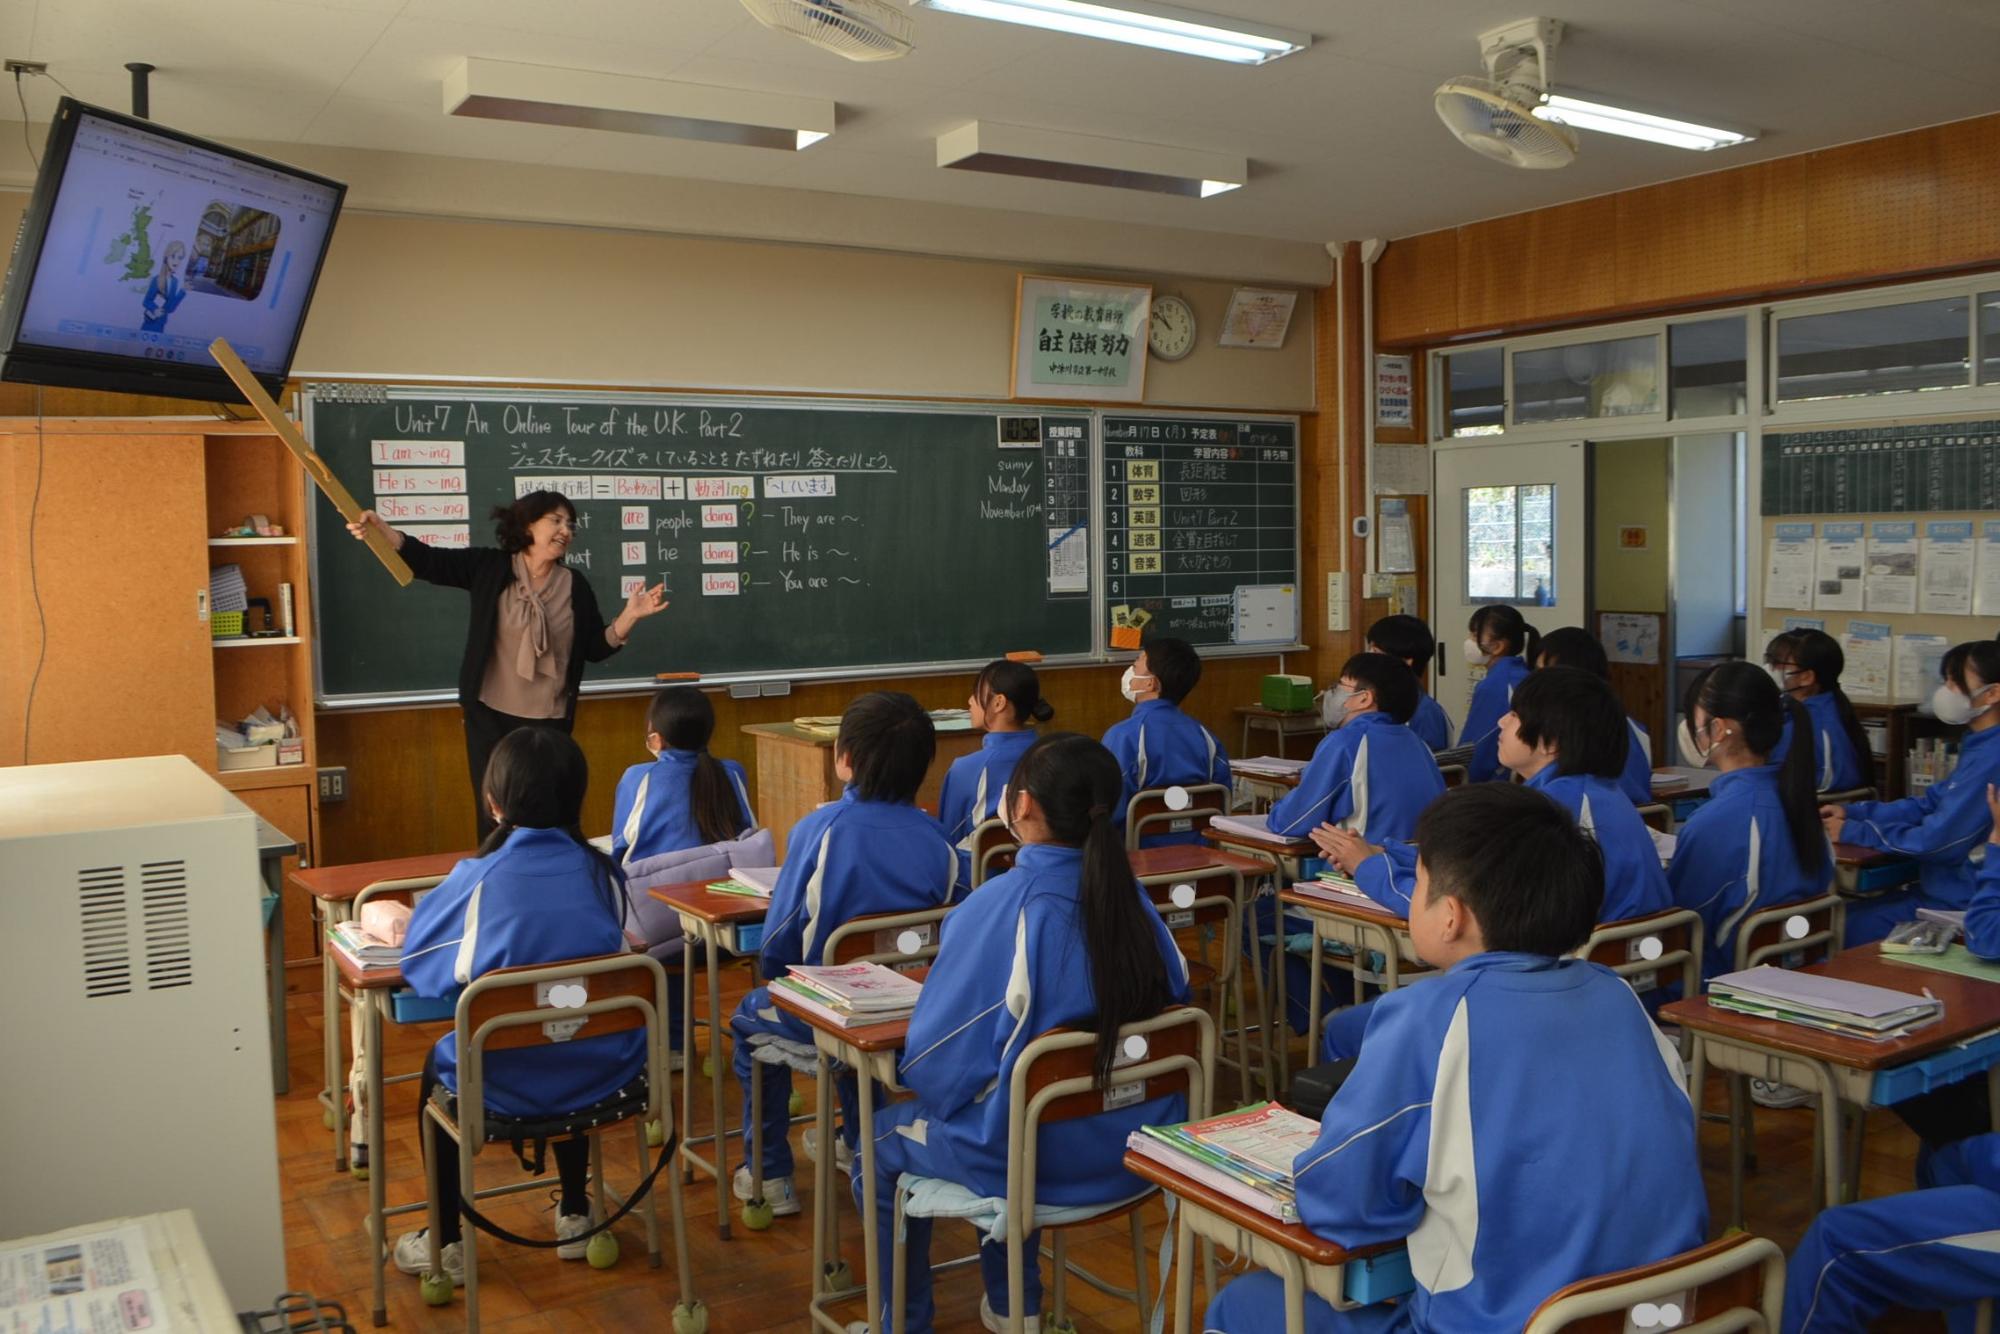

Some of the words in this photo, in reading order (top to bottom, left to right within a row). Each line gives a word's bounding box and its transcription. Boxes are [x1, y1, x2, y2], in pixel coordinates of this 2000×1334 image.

[1039, 328, 1064, 352] 自主
[1069, 332, 1097, 355] 信頼
[1101, 334, 1129, 357] 努力
[465, 403, 489, 436] An
[503, 404, 552, 434] Online
[562, 407, 595, 435] Tour
[600, 407, 619, 436] of
[625, 412, 648, 436] the
[655, 410, 688, 436] U.K.
[1128, 425, 1137, 438] 月
[1151, 426, 1160, 438] 日
[1191, 427, 1217, 441] 予定表
[393, 446, 411, 460] am
[1125, 445, 1144, 458] 教科
[1193, 447, 1229, 460] 学習内容
[1263, 449, 1288, 461] 持ち物
[1111, 466, 1116, 477] 1
[1132, 465, 1153, 478] 体育
[379, 473, 399, 489] He
[404, 475, 416, 489] is
[1048, 479, 1054, 488] 2
[1048, 496, 1054, 505] 3
[1111, 488, 1118, 500] 2
[1133, 488, 1154, 502] 数学
[382, 500, 408, 516] She
[414, 502, 426, 515] is
[623, 511, 646, 525] are
[653, 510, 693, 539] people
[781, 506, 812, 534] They
[815, 513, 833, 526] are
[1048, 512, 1056, 520] 4
[1112, 512, 1118, 524] 3
[1134, 510, 1155, 525] 英語
[1111, 535, 1119, 547] 4
[1134, 534, 1155, 547] 道徳
[626, 543, 639, 560] is
[656, 540, 679, 562] he
[782, 542, 801, 563] He
[807, 546, 818, 562] is
[1112, 558, 1119, 569] 5
[1135, 557, 1156, 571] 音楽
[778, 571, 801, 593] You
[806, 577, 828, 590] are
[1112, 581, 1119, 592] 6
